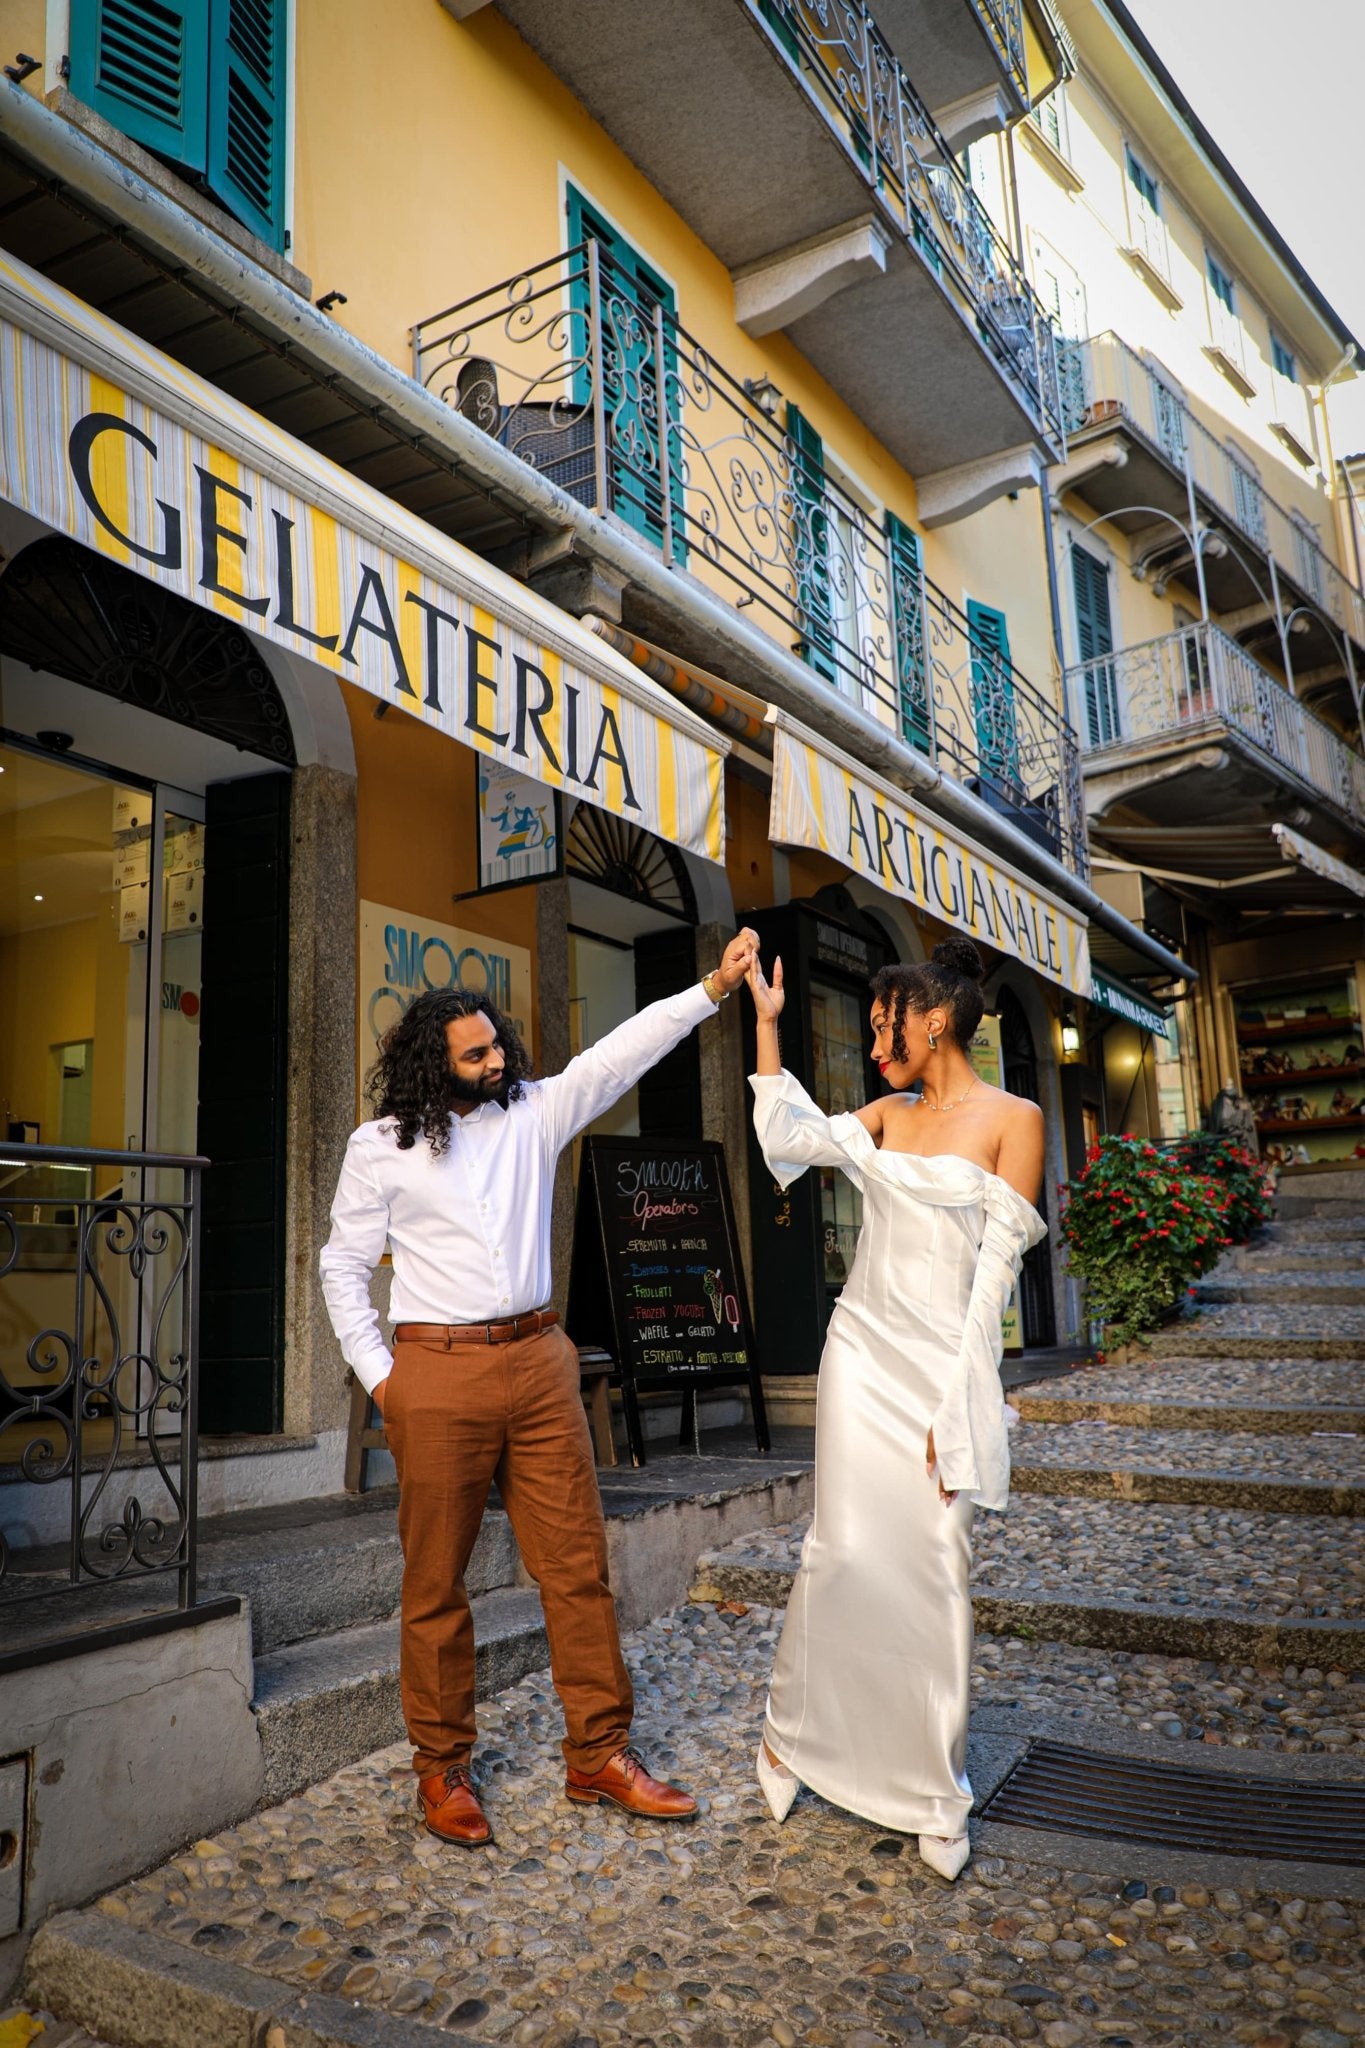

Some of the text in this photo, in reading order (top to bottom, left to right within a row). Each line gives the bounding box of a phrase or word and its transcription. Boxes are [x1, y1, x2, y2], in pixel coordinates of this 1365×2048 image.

[68, 411, 643, 812] GELATERIA
[846, 787, 1063, 976] ARTIGIANALE
[384, 922, 511, 1012] SMOOTH
[1106, 986, 1168, 1037] MINIMARKET
[633, 1190, 699, 1231] Operators
[639, 1325, 670, 1341] WAFFLE
[687, 1325, 716, 1337] GELATO
[643, 1350, 684, 1364] ESTRATTO
